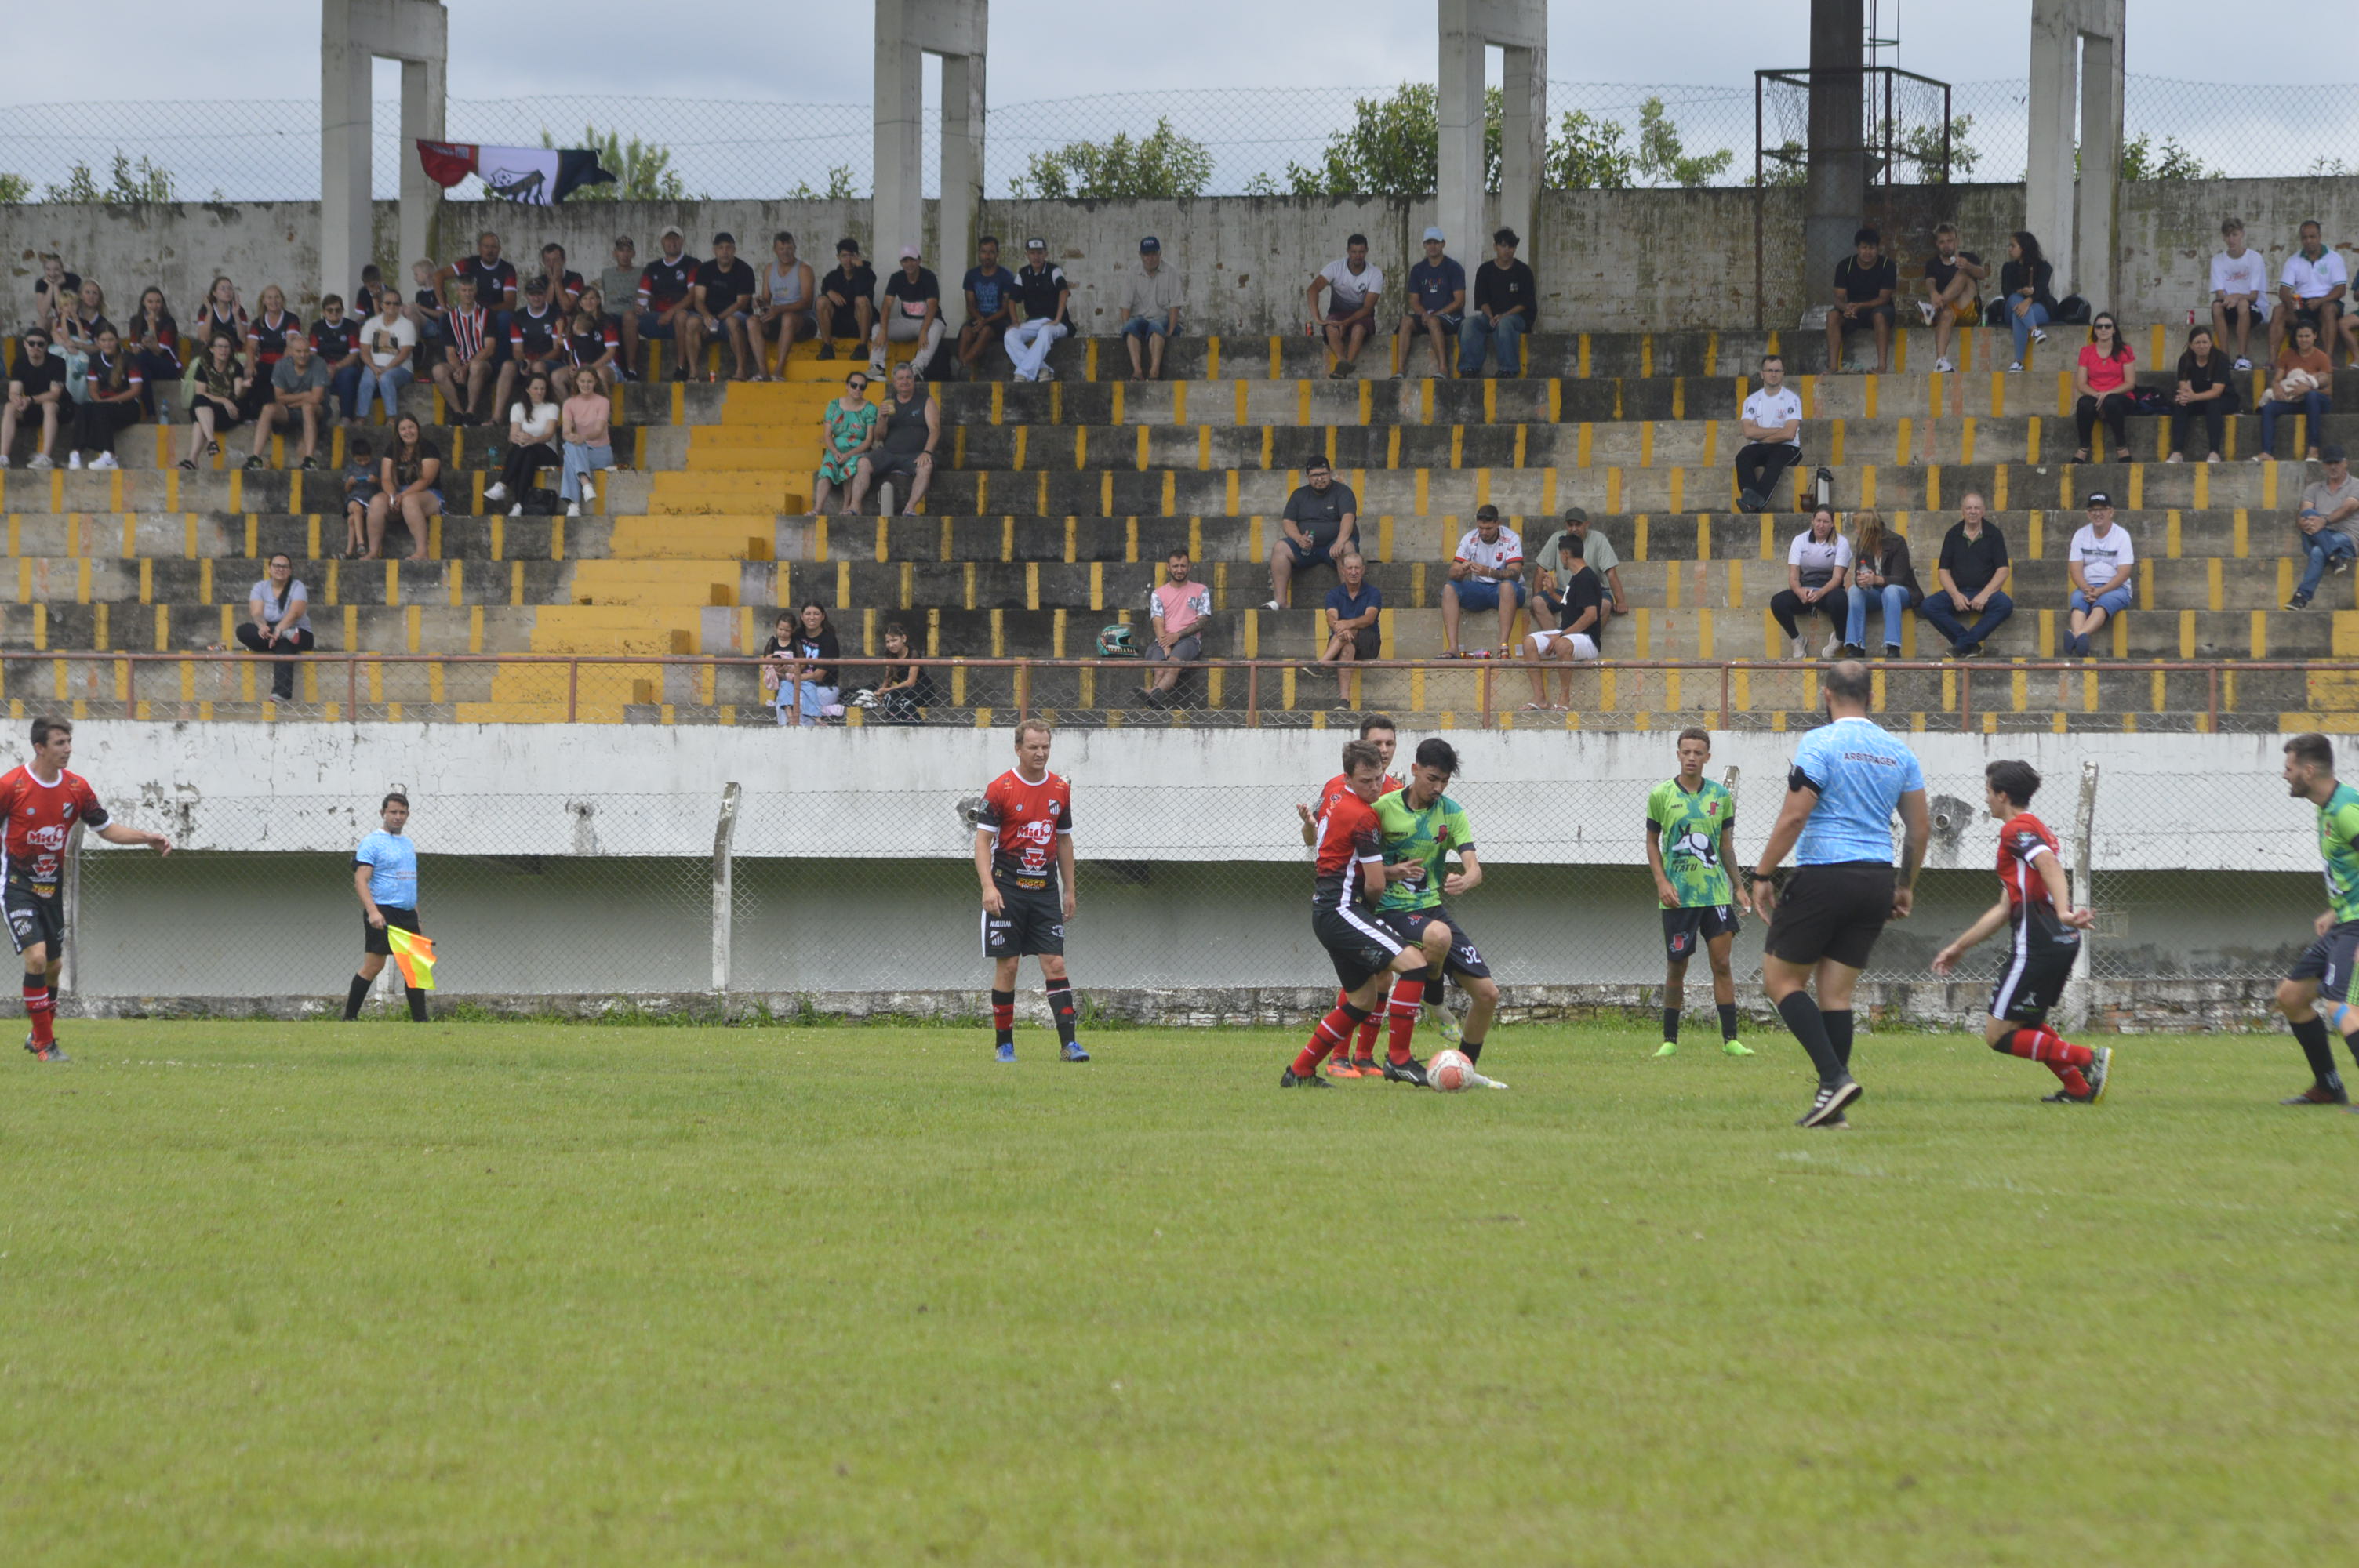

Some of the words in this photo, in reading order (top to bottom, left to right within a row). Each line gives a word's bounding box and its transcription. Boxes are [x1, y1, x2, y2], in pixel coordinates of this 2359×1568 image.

[1845, 752, 1896, 766] ARBITRAGEM
[1674, 863, 1698, 873] TATU
[1460, 946, 1481, 964] 32
